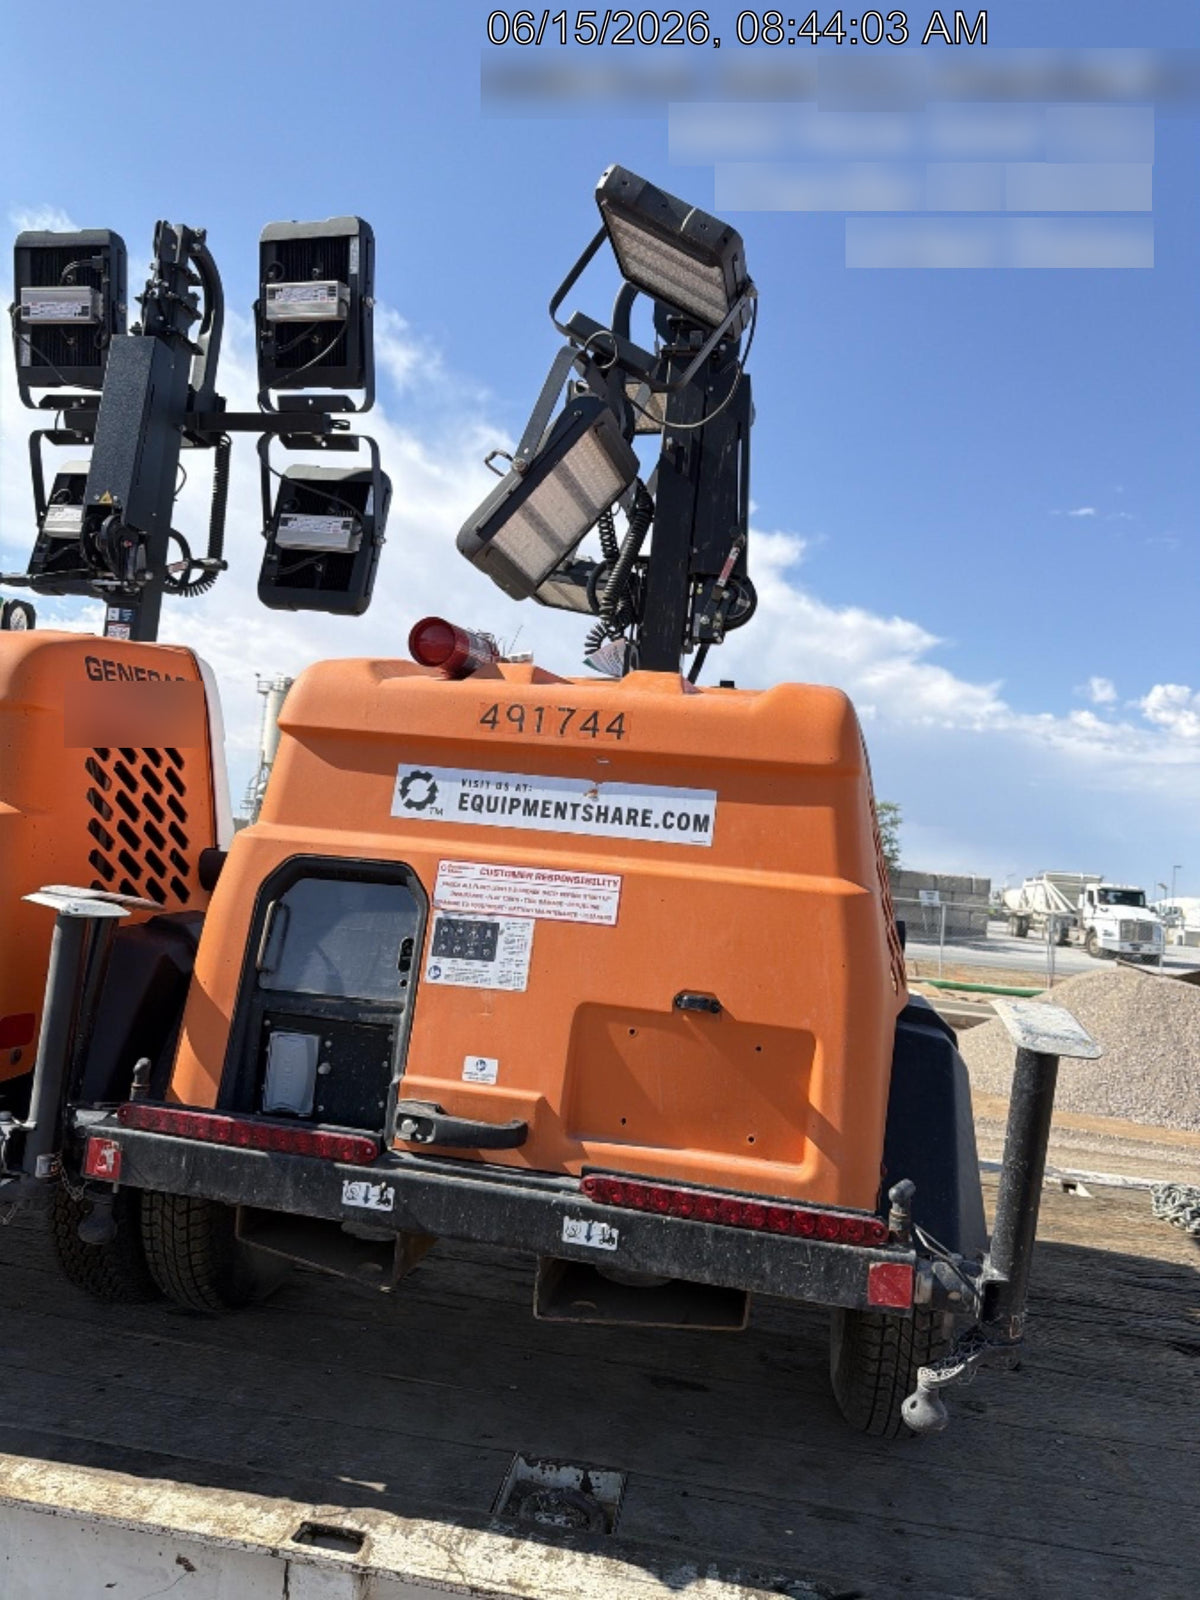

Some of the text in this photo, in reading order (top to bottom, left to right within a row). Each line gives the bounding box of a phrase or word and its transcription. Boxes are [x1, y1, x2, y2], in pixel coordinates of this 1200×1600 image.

[84, 655, 187, 682] GENE
[479, 703, 626, 740] 491744
[461, 778, 533, 793] VISIT US AT:
[458, 792, 710, 833] EQUIPMENTSHARE.COM
[479, 866, 619, 888] CUSTOMER RESPONSIBILITY
